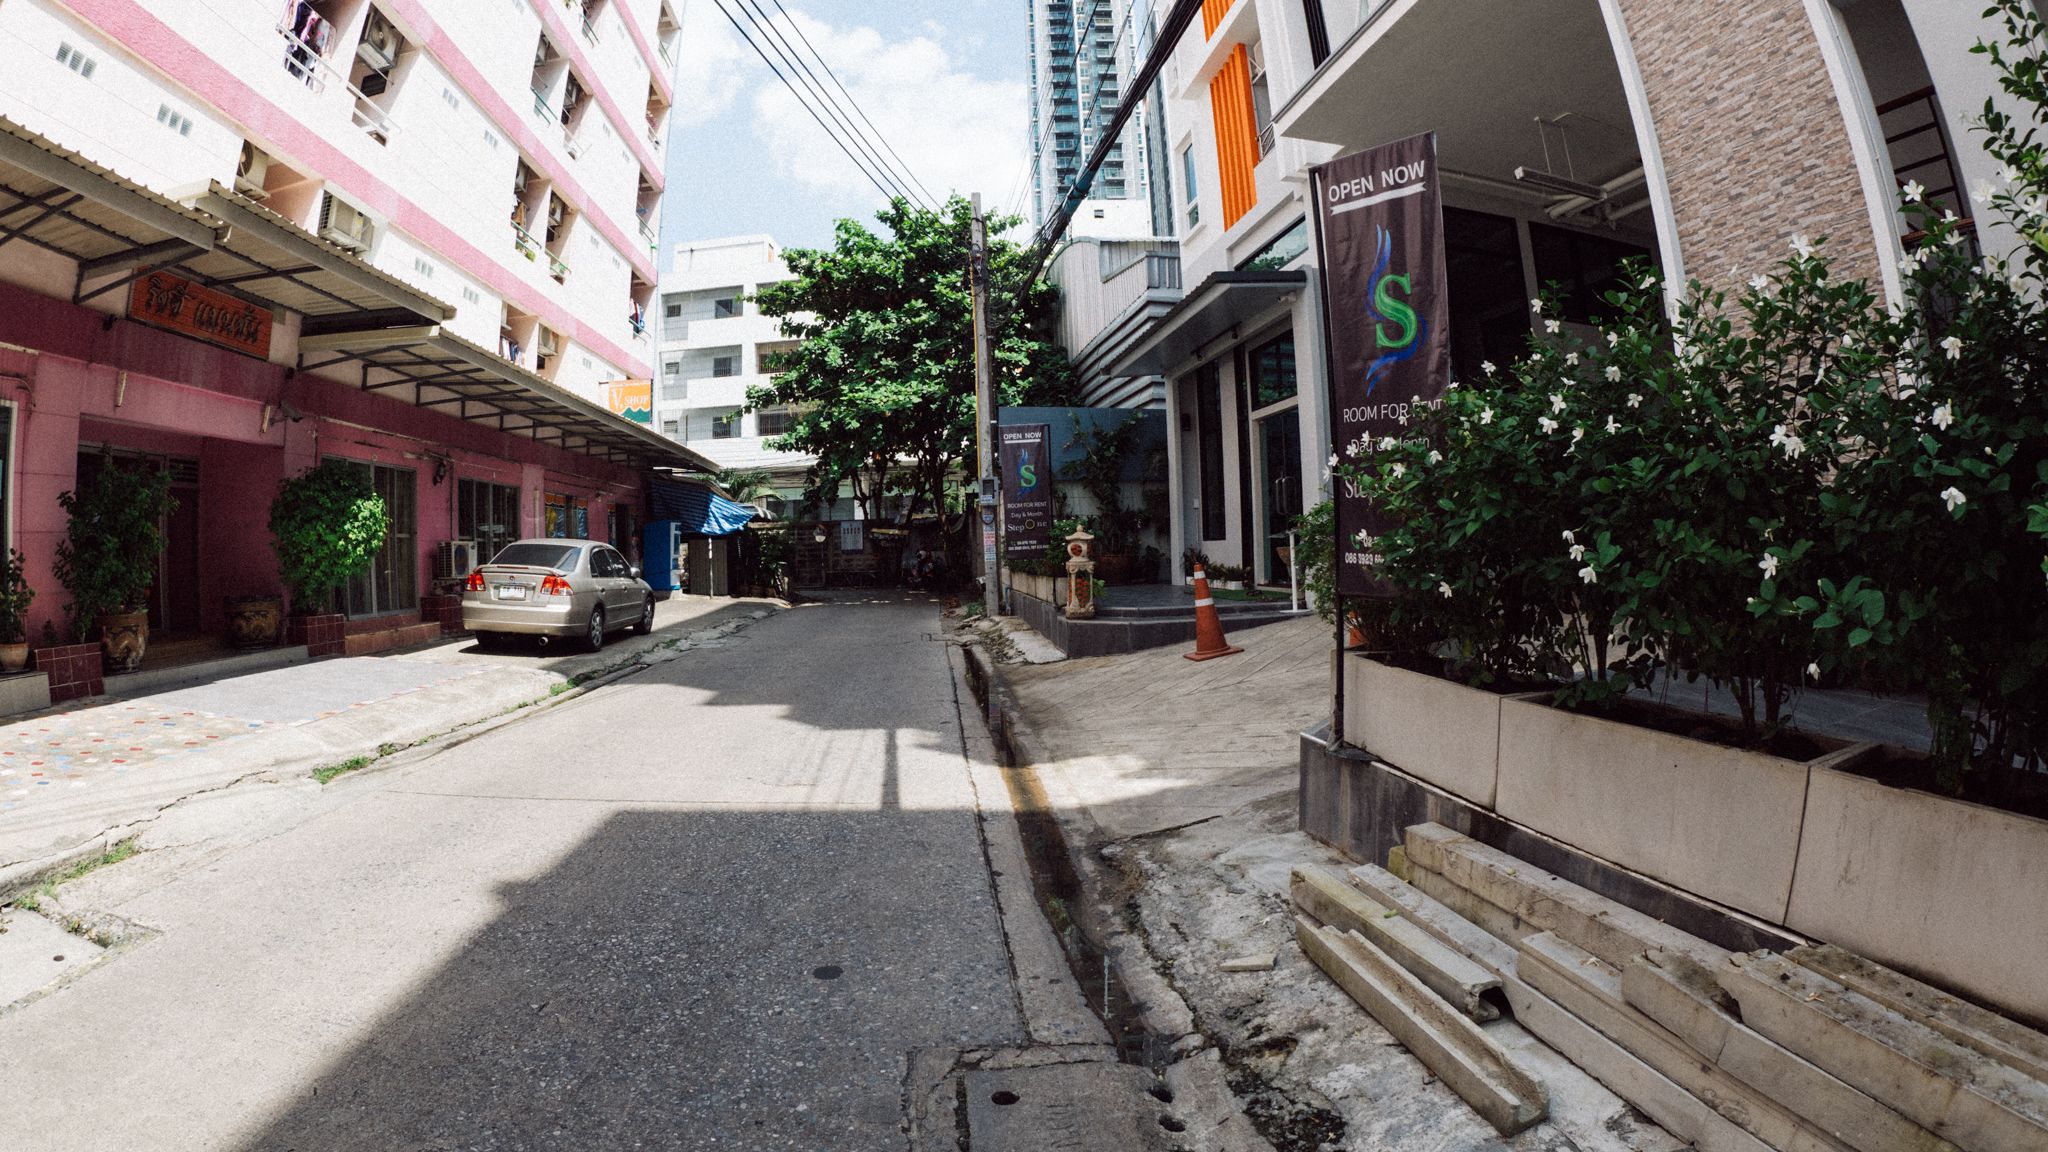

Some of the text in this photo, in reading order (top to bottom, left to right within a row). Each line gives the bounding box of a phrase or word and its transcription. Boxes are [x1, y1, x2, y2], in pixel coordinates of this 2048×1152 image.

[1328, 160, 1425, 203] OPEN NOW
[1375, 272, 1418, 348] S
[1343, 405, 1378, 424] ROOM
[1380, 403, 1410, 419] FOR
[1003, 431, 1042, 440] OPEN NOW
[1350, 439, 1374, 456] Day
[1021, 464, 1037, 487] S
[1007, 523, 1025, 533] Step
